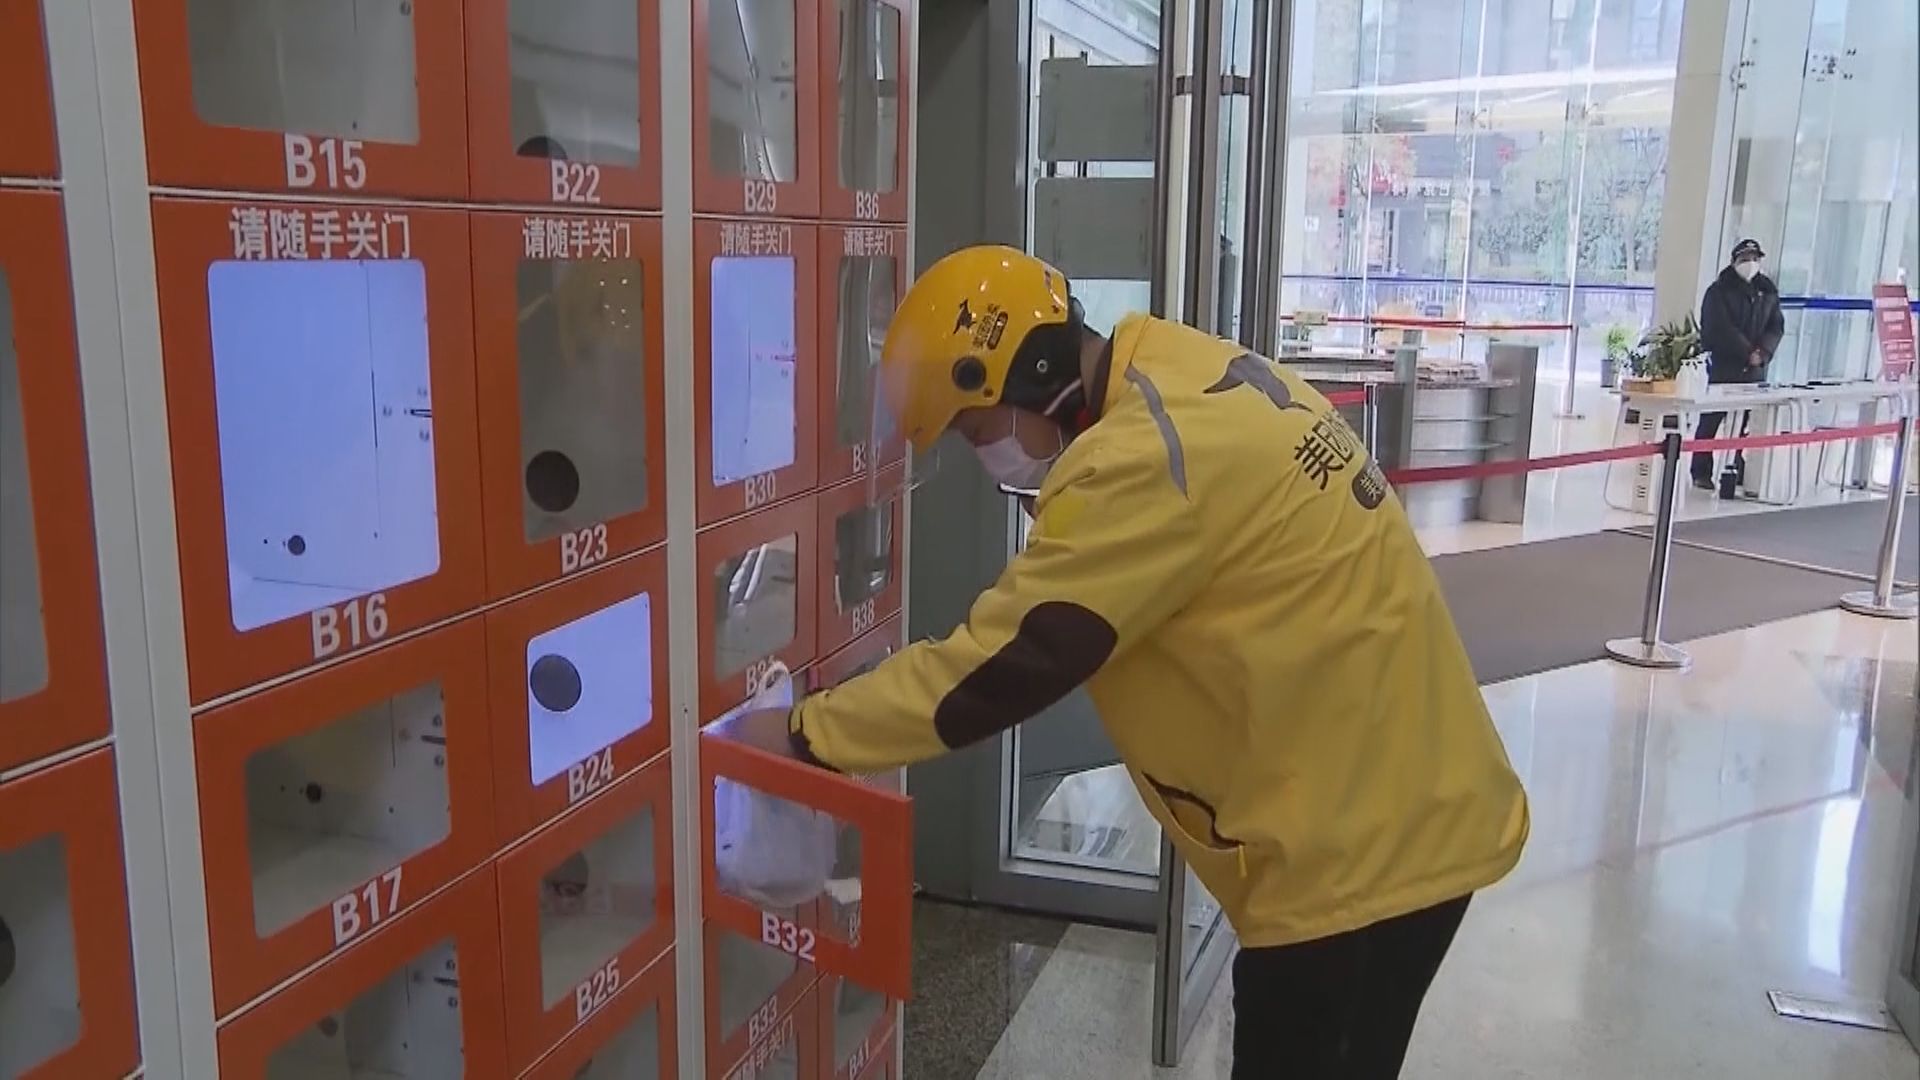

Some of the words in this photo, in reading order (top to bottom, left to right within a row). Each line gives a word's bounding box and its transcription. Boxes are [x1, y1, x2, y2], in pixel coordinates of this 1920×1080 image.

[284, 133, 367, 189] B15
[551, 159, 600, 204] B22
[744, 181, 777, 213] B29
[856, 191, 879, 219] B36
[229, 207, 411, 260] 请随手关门
[523, 216, 631, 259] 请随手关门
[721, 223, 791, 256] 请随手关门
[844, 229, 894, 256] 请随手关门
[745, 471, 776, 509] B30
[561, 523, 608, 574] B23
[312, 593, 388, 659] B16
[853, 597, 875, 634] B38
[568, 746, 614, 804] B24
[333, 865, 402, 947] B17
[762, 911, 816, 962] B32
[576, 956, 619, 1022] B25
[749, 995, 777, 1046] B33
[850, 1037, 870, 1078] B41
